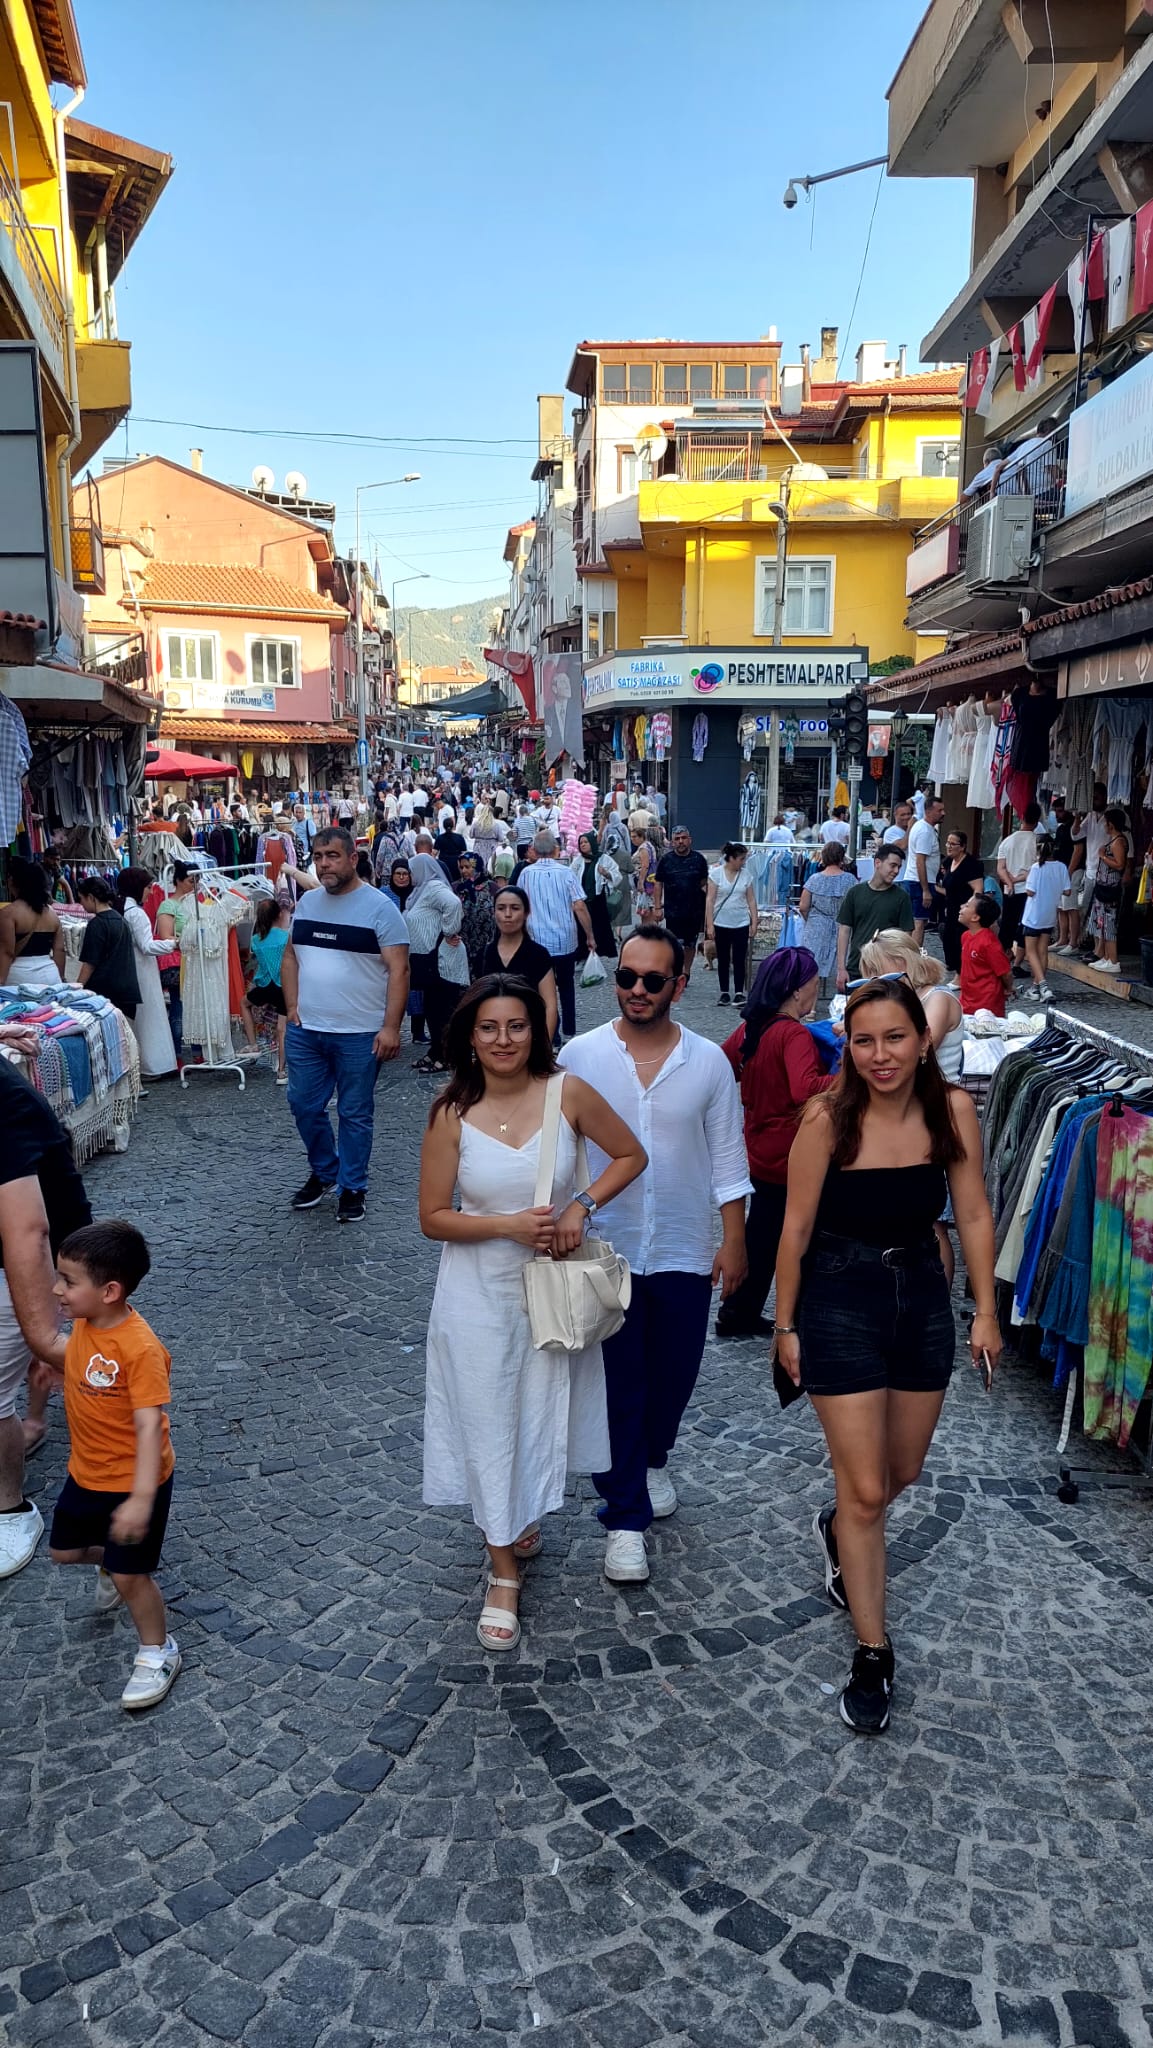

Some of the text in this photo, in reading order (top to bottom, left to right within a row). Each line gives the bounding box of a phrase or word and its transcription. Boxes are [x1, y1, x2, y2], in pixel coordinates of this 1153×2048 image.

[1096, 439, 1139, 489] BULDAN
[630, 660, 664, 673] FABRİKA
[617, 677, 639, 689] SATIŞ
[639, 674, 681, 688] MAĞAZASI
[230, 696, 262, 705] KURUMU
